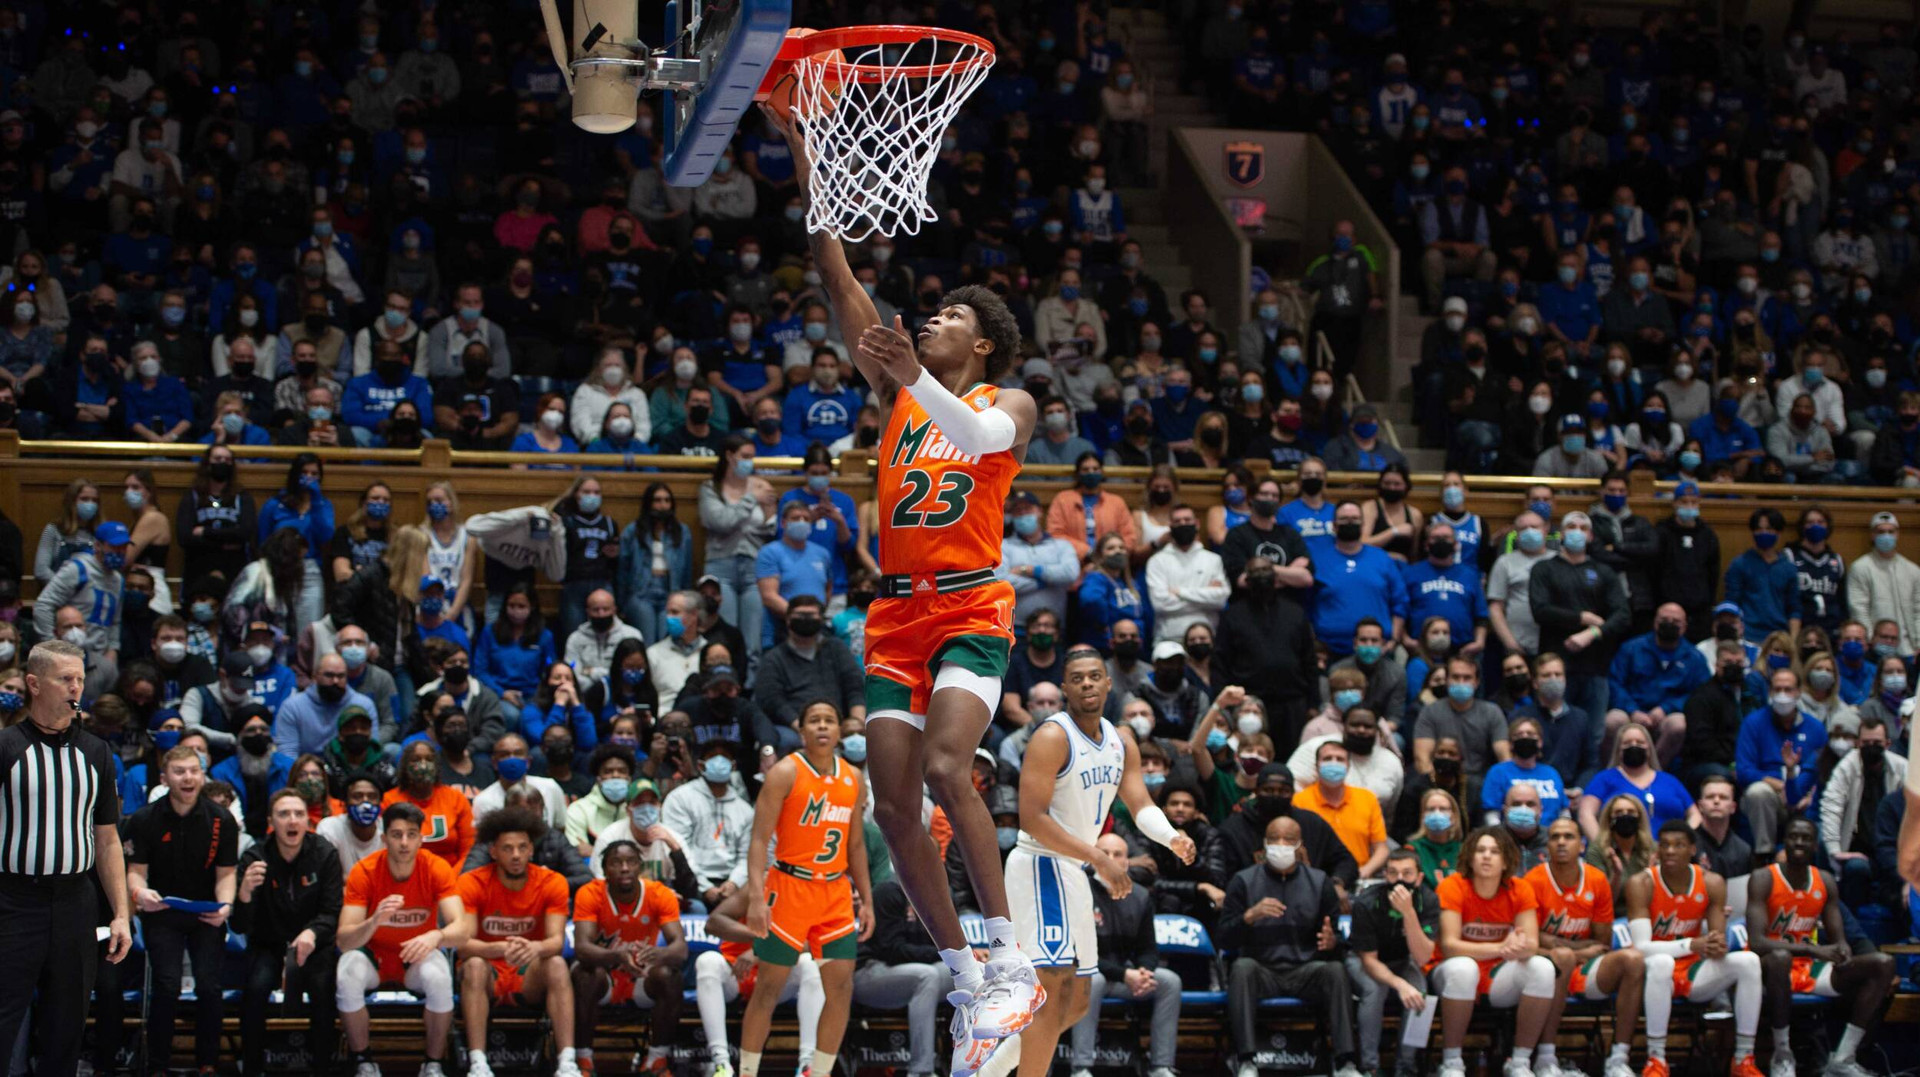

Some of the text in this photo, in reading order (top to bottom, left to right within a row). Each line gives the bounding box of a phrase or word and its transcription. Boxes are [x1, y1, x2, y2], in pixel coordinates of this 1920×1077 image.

[1234, 153, 1253, 179] 7
[891, 468, 975, 529] 23
[1081, 765, 1123, 790] DUKE
[797, 790, 852, 827] Miam
[1094, 788, 1103, 826] 1
[814, 827, 844, 865] 3
[1043, 925, 1063, 942] D
[1543, 906, 1590, 935] Miam
[860, 1047, 911, 1062] Therab
[1253, 1050, 1317, 1069] erabody
